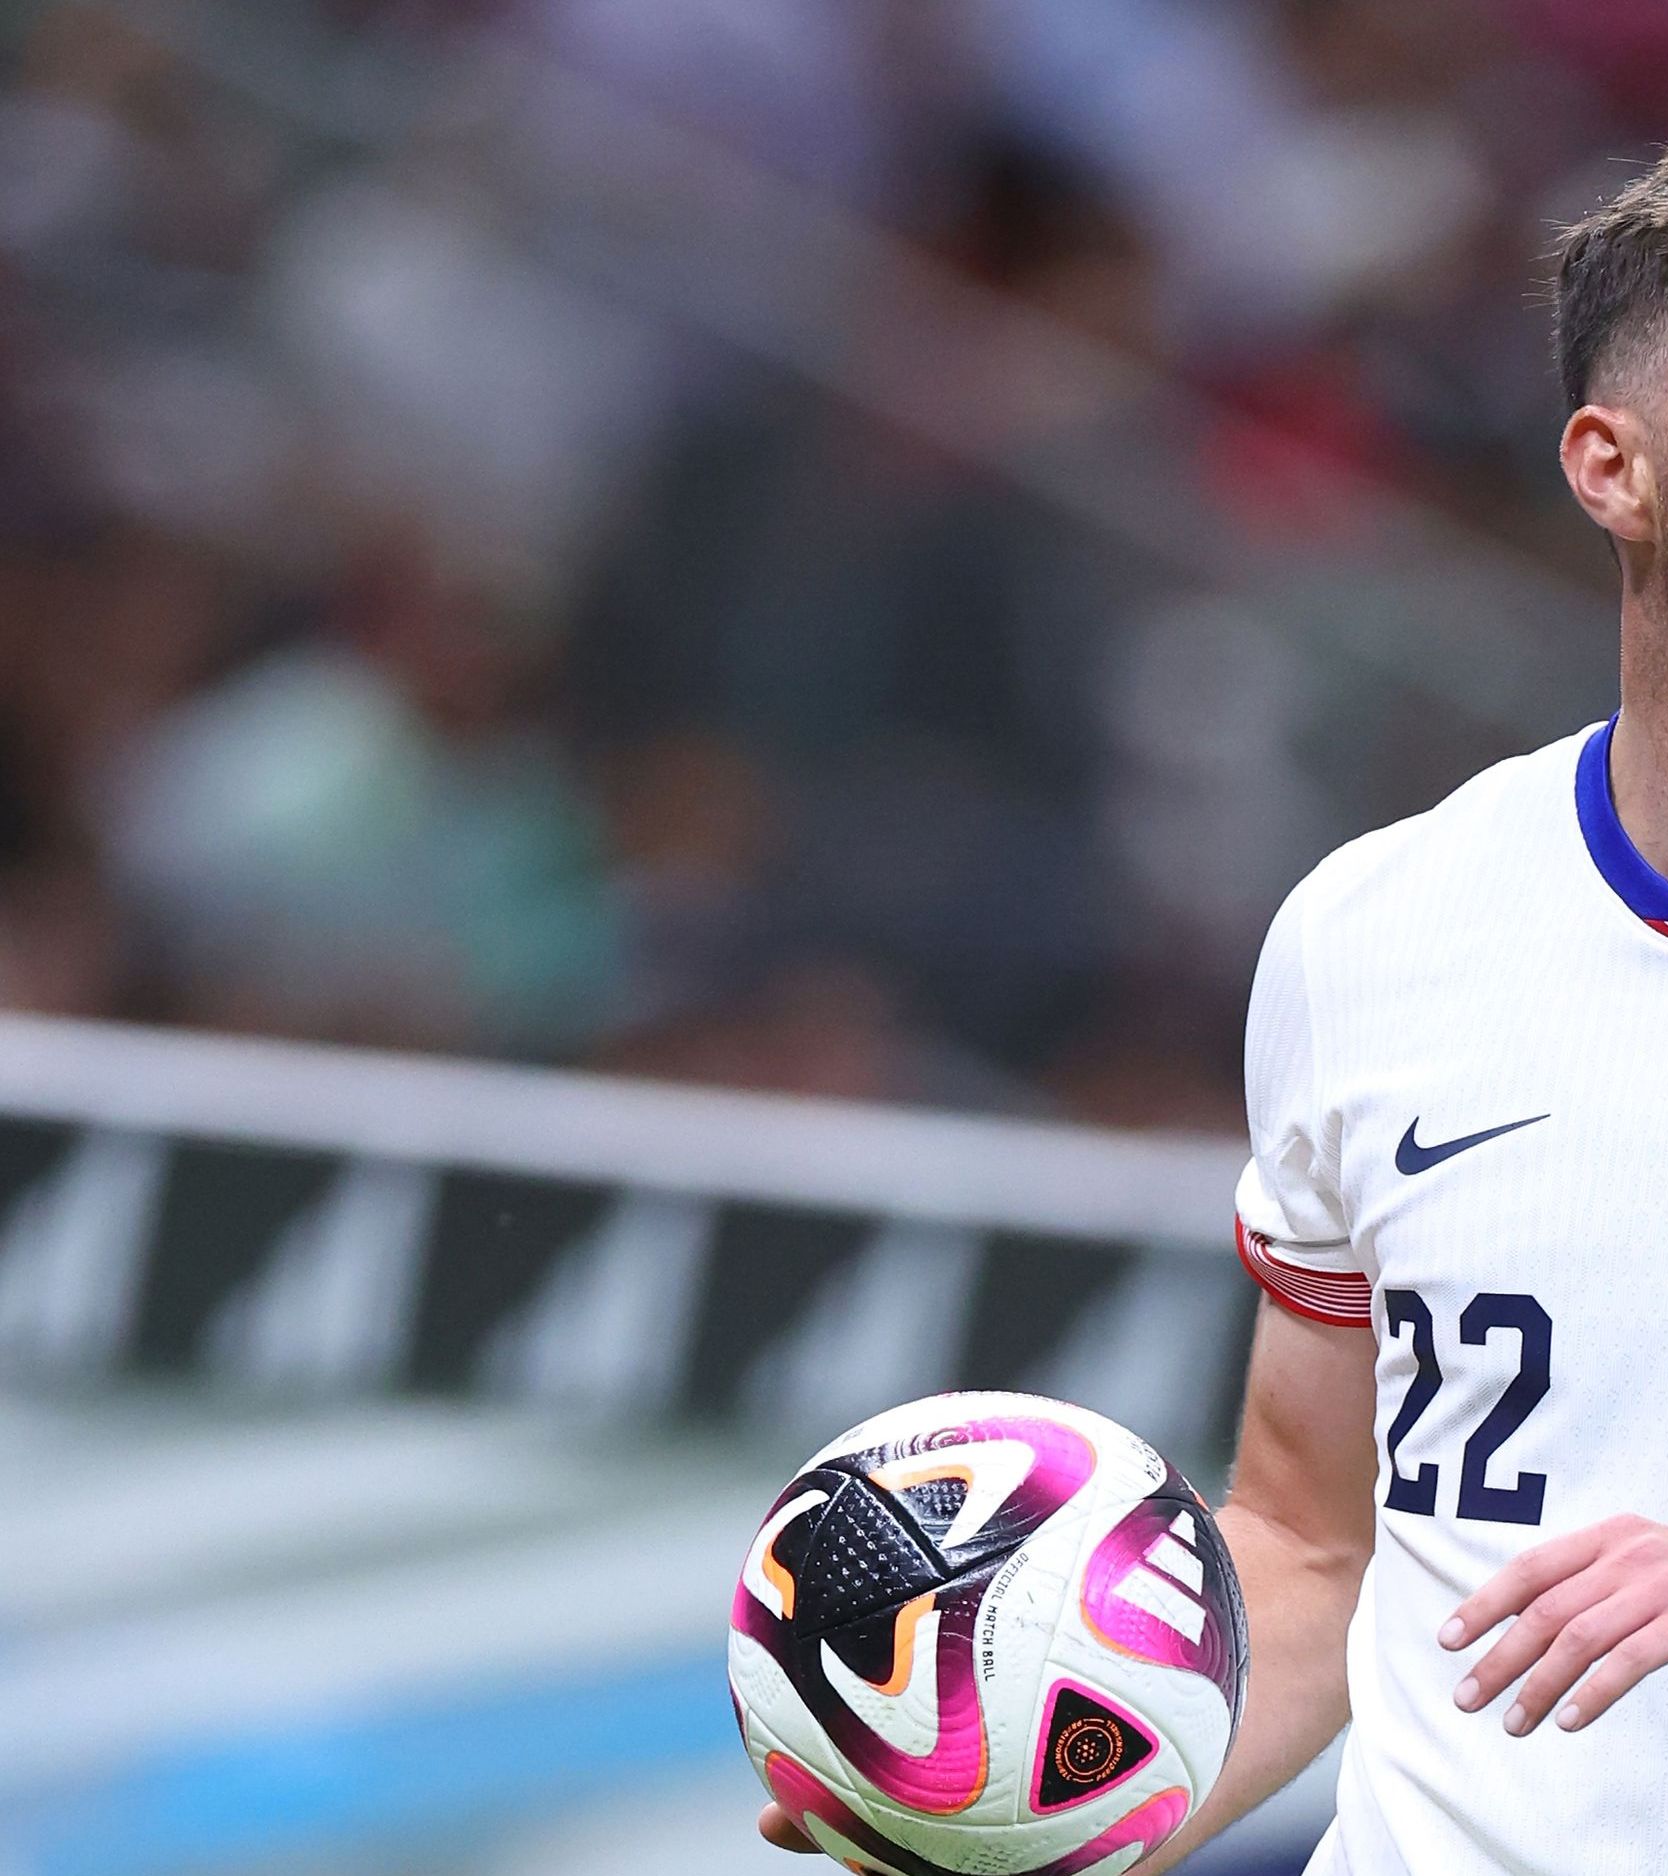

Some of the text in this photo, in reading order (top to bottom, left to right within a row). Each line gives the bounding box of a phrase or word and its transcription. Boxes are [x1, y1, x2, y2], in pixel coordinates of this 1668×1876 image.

[1384, 1289, 1554, 1526] 22
[982, 1552, 1029, 1682] OFFICIAL MATCH BALL
